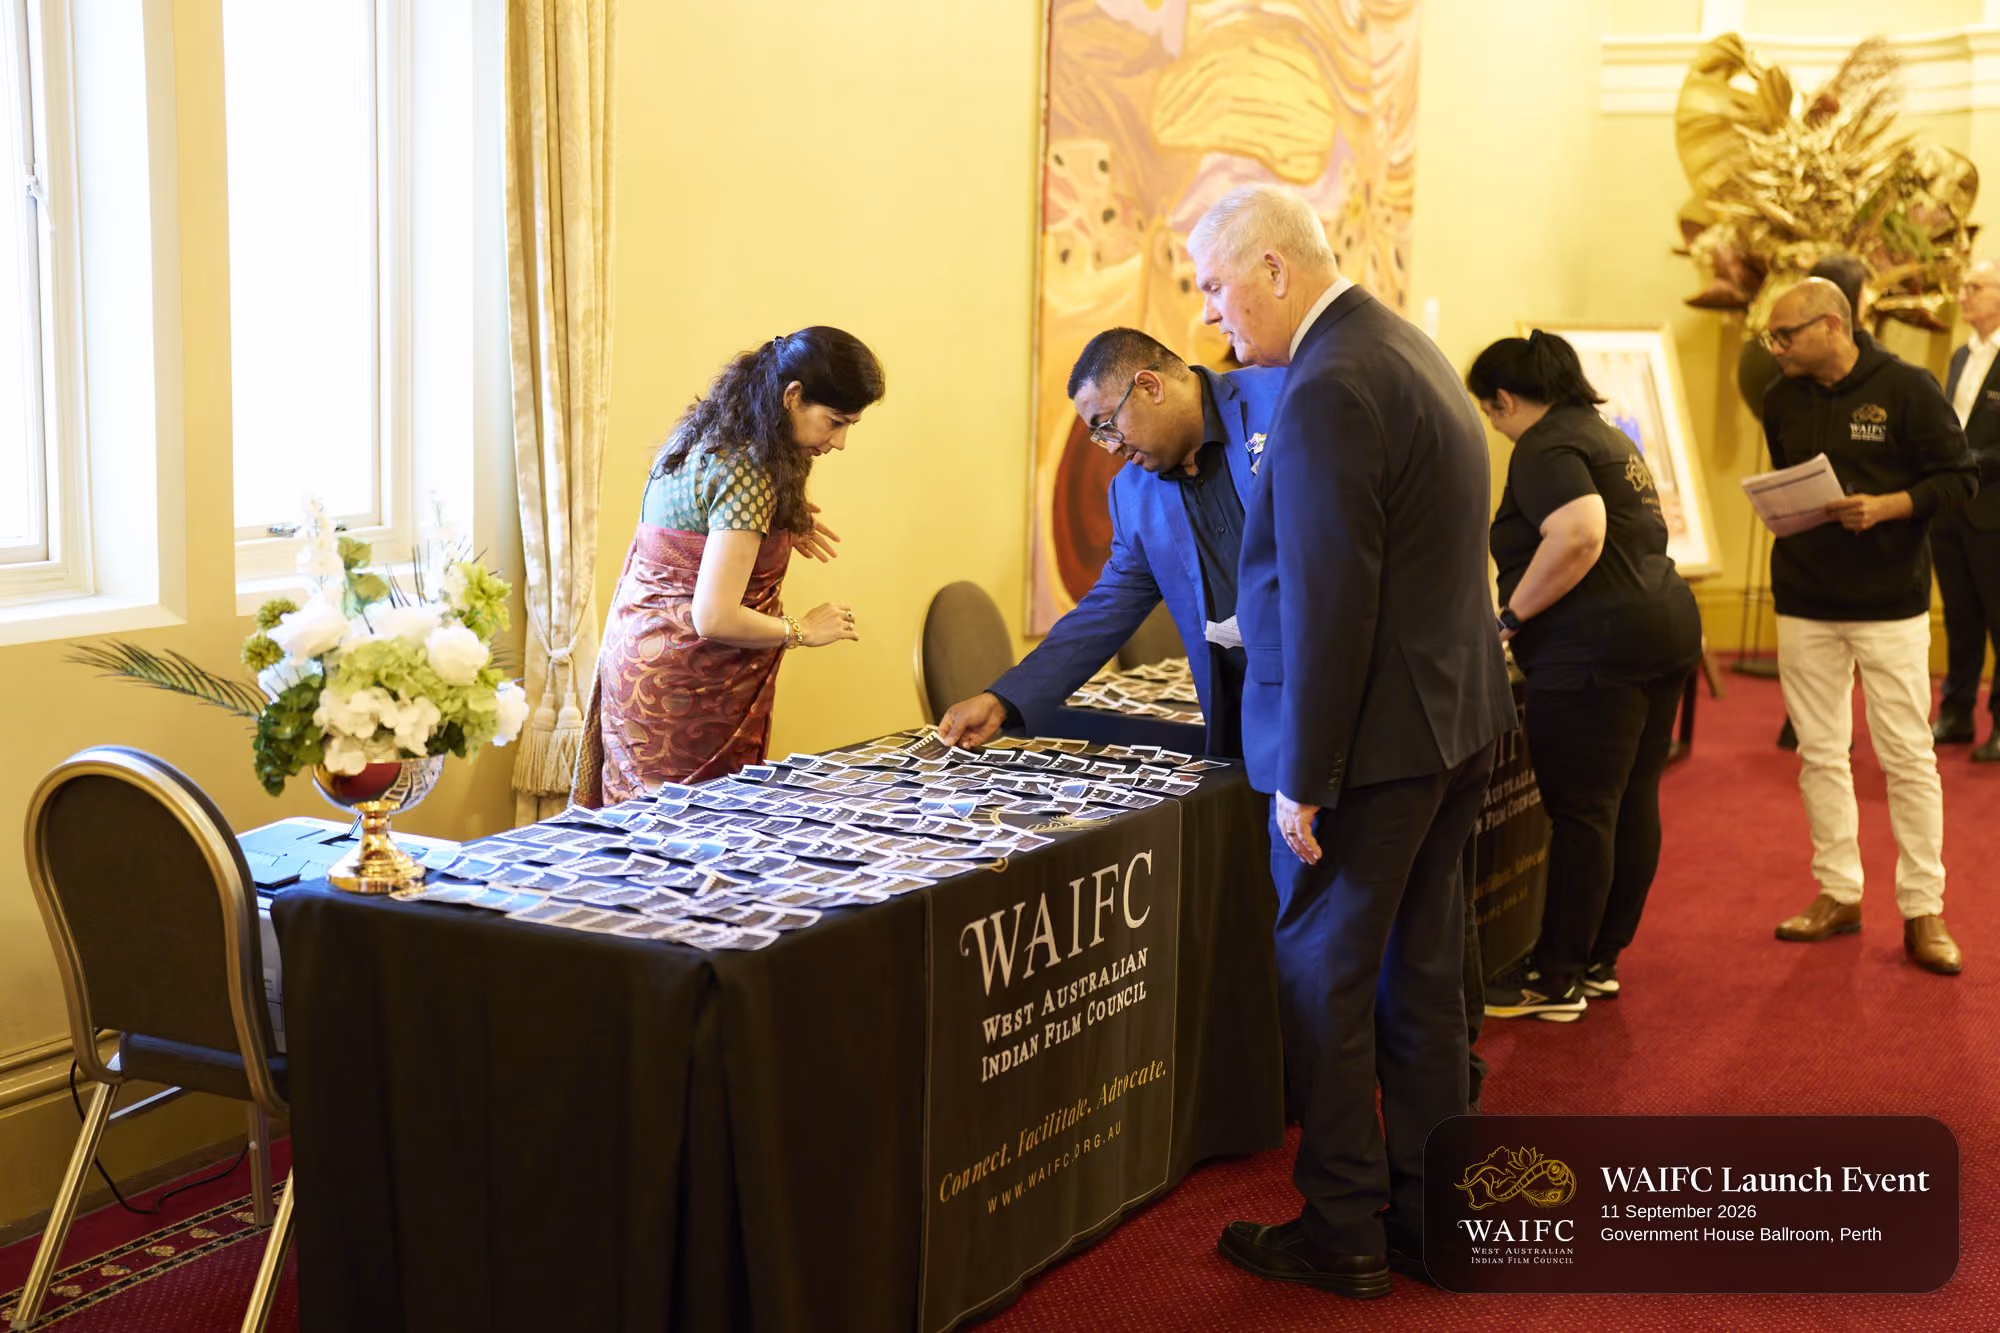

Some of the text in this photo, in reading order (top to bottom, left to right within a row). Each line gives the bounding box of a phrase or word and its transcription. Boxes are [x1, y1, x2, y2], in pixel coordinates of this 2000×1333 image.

[1849, 422, 1886, 434] WAIFC
[960, 849, 1153, 997] WAIFC
[981, 981, 1147, 1083] INDIAN FILM COUNCIL
[982, 947, 1149, 1044] WEST AUSTRALIAN
[939, 1060, 1167, 1203] Connect. Facilitate. Advocate.
